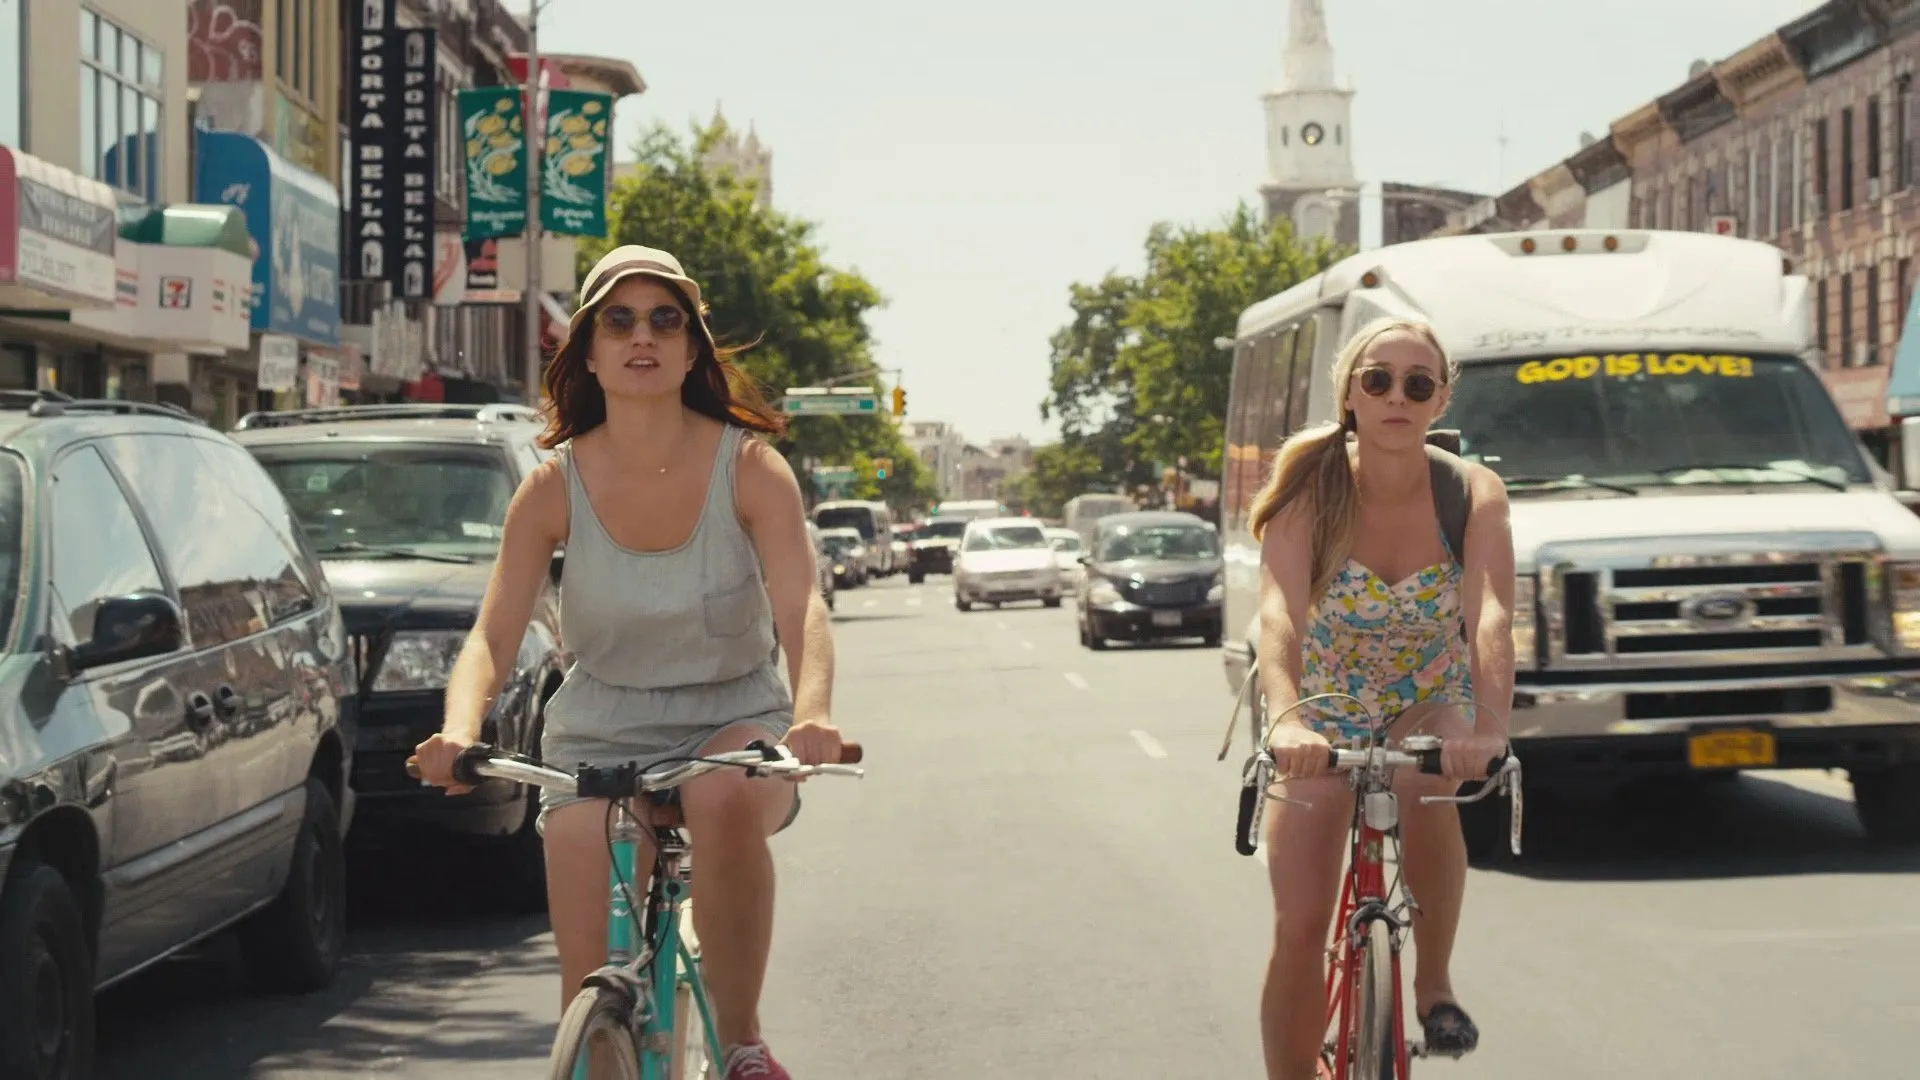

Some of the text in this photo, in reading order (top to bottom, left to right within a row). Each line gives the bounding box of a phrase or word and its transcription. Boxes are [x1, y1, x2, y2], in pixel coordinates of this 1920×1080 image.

[360, 35, 385, 237] PORTA BELLA
[404, 71, 427, 258] PORTA BELLA
[1516, 354, 1753, 384] GOD IS LOVE!
